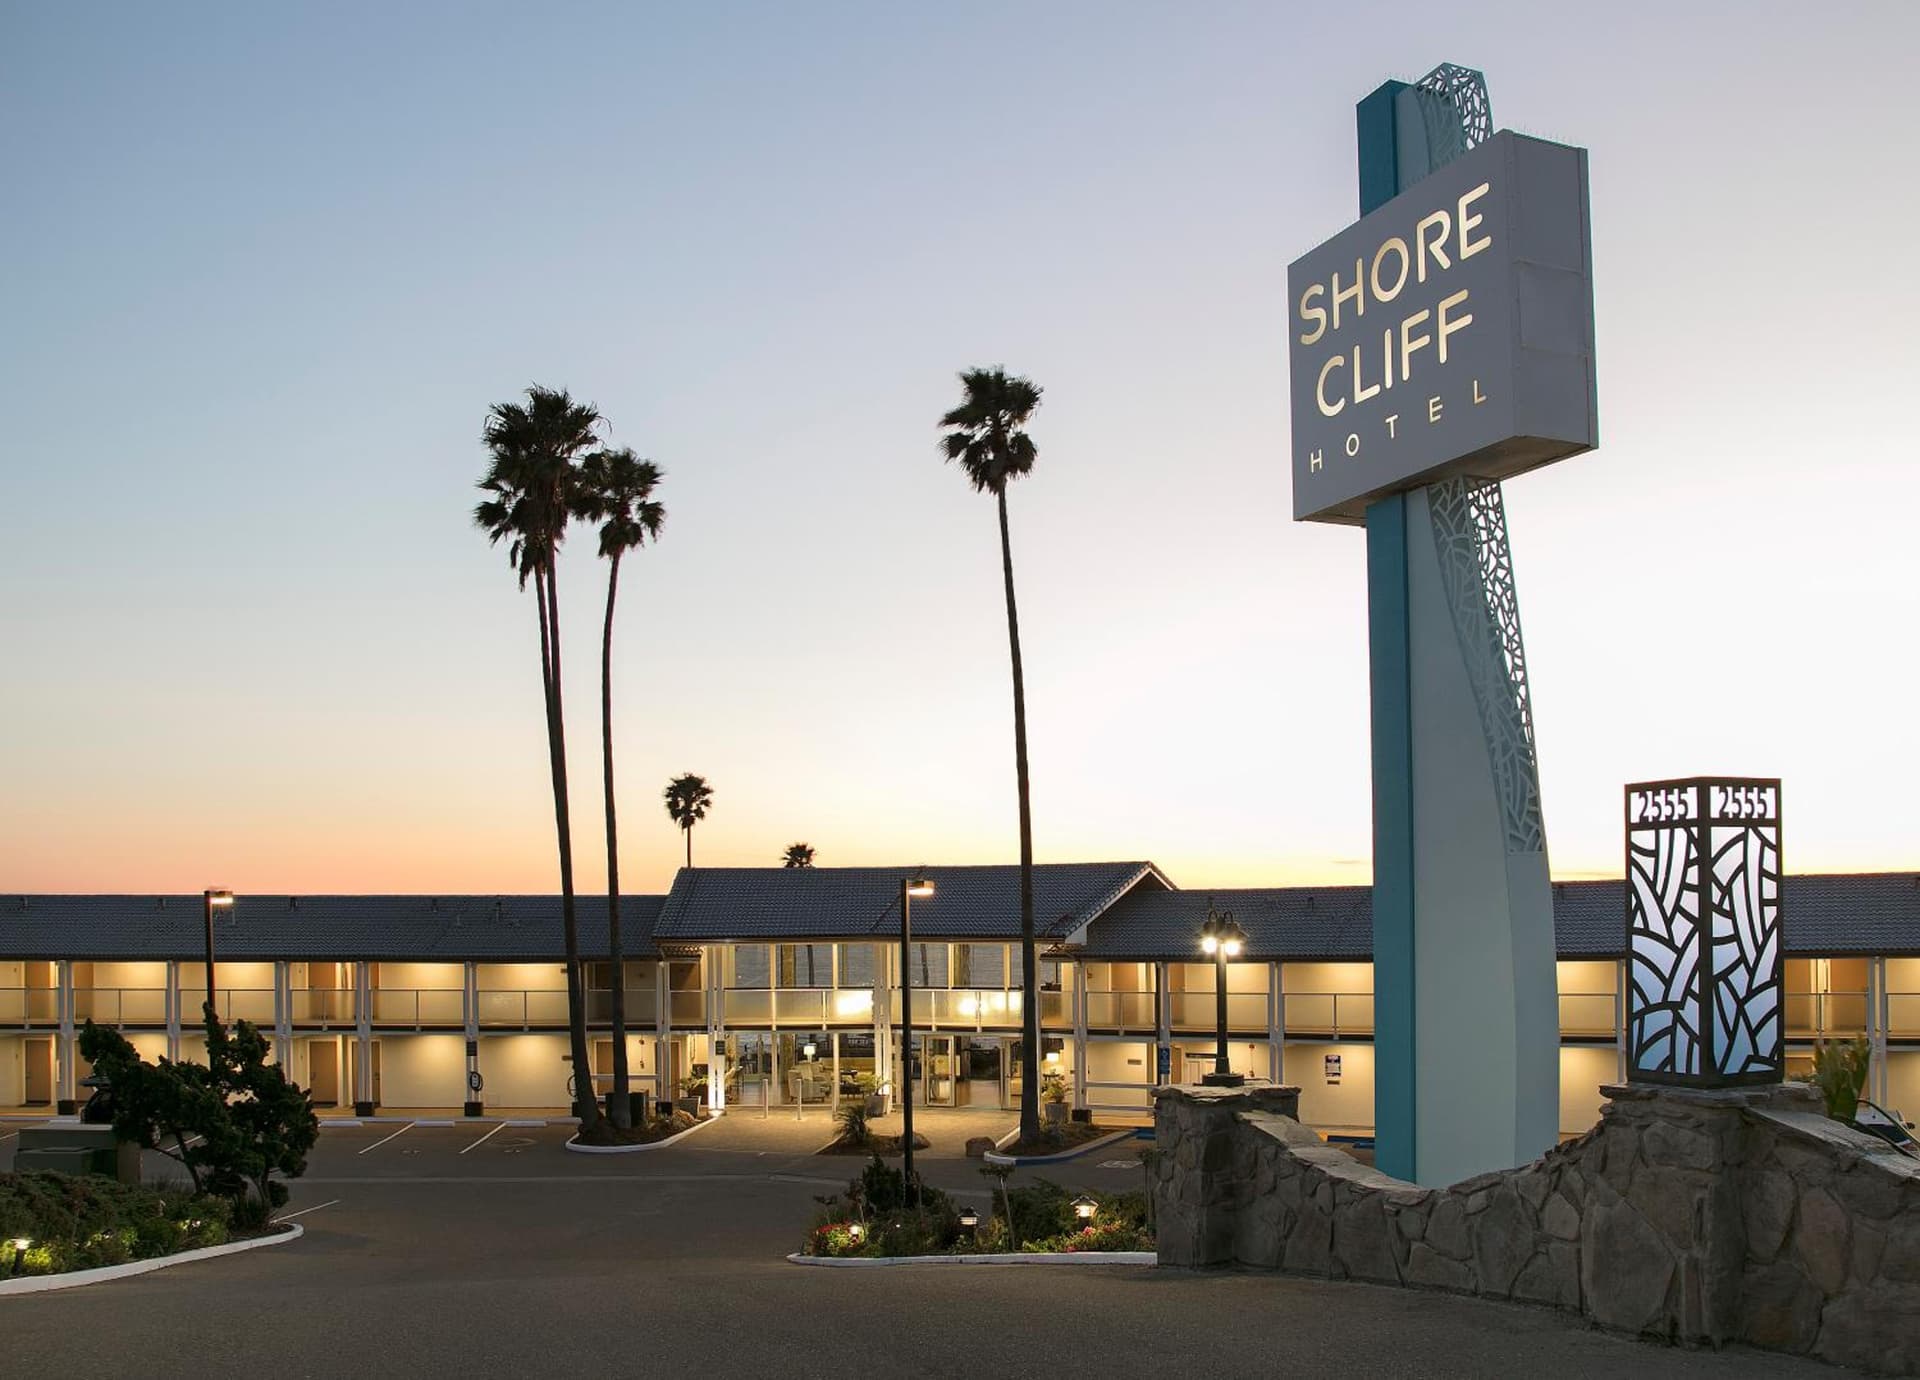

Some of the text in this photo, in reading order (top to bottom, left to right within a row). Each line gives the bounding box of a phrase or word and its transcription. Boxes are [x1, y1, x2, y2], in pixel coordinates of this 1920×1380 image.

[1300, 182, 1492, 345] SHORE
[1316, 289, 1473, 417] CLIFF
[1309, 379, 1487, 473] HOTEL
[1639, 788, 1688, 823] 2555
[1719, 786, 1767, 819] 2555
